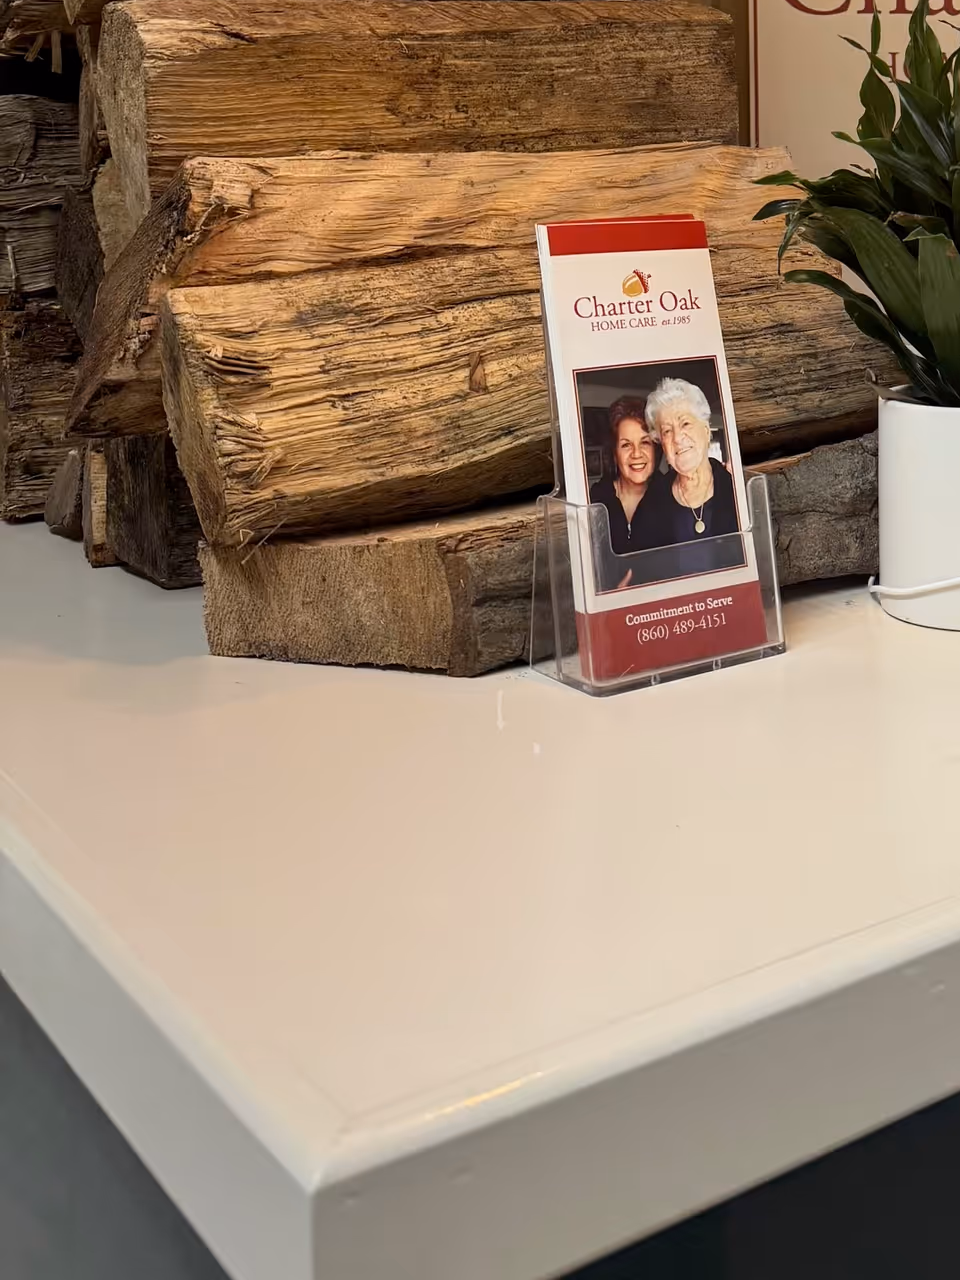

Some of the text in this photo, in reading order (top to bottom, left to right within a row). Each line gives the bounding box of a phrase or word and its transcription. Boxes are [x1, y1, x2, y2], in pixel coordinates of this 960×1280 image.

[574, 289, 702, 318] Charter Oak
[591, 318, 627, 332] HOME
[628, 317, 658, 328] CARE
[625, 596, 733, 626] Commitment to Serve
[637, 612, 727, 645] (860) 489-4151
